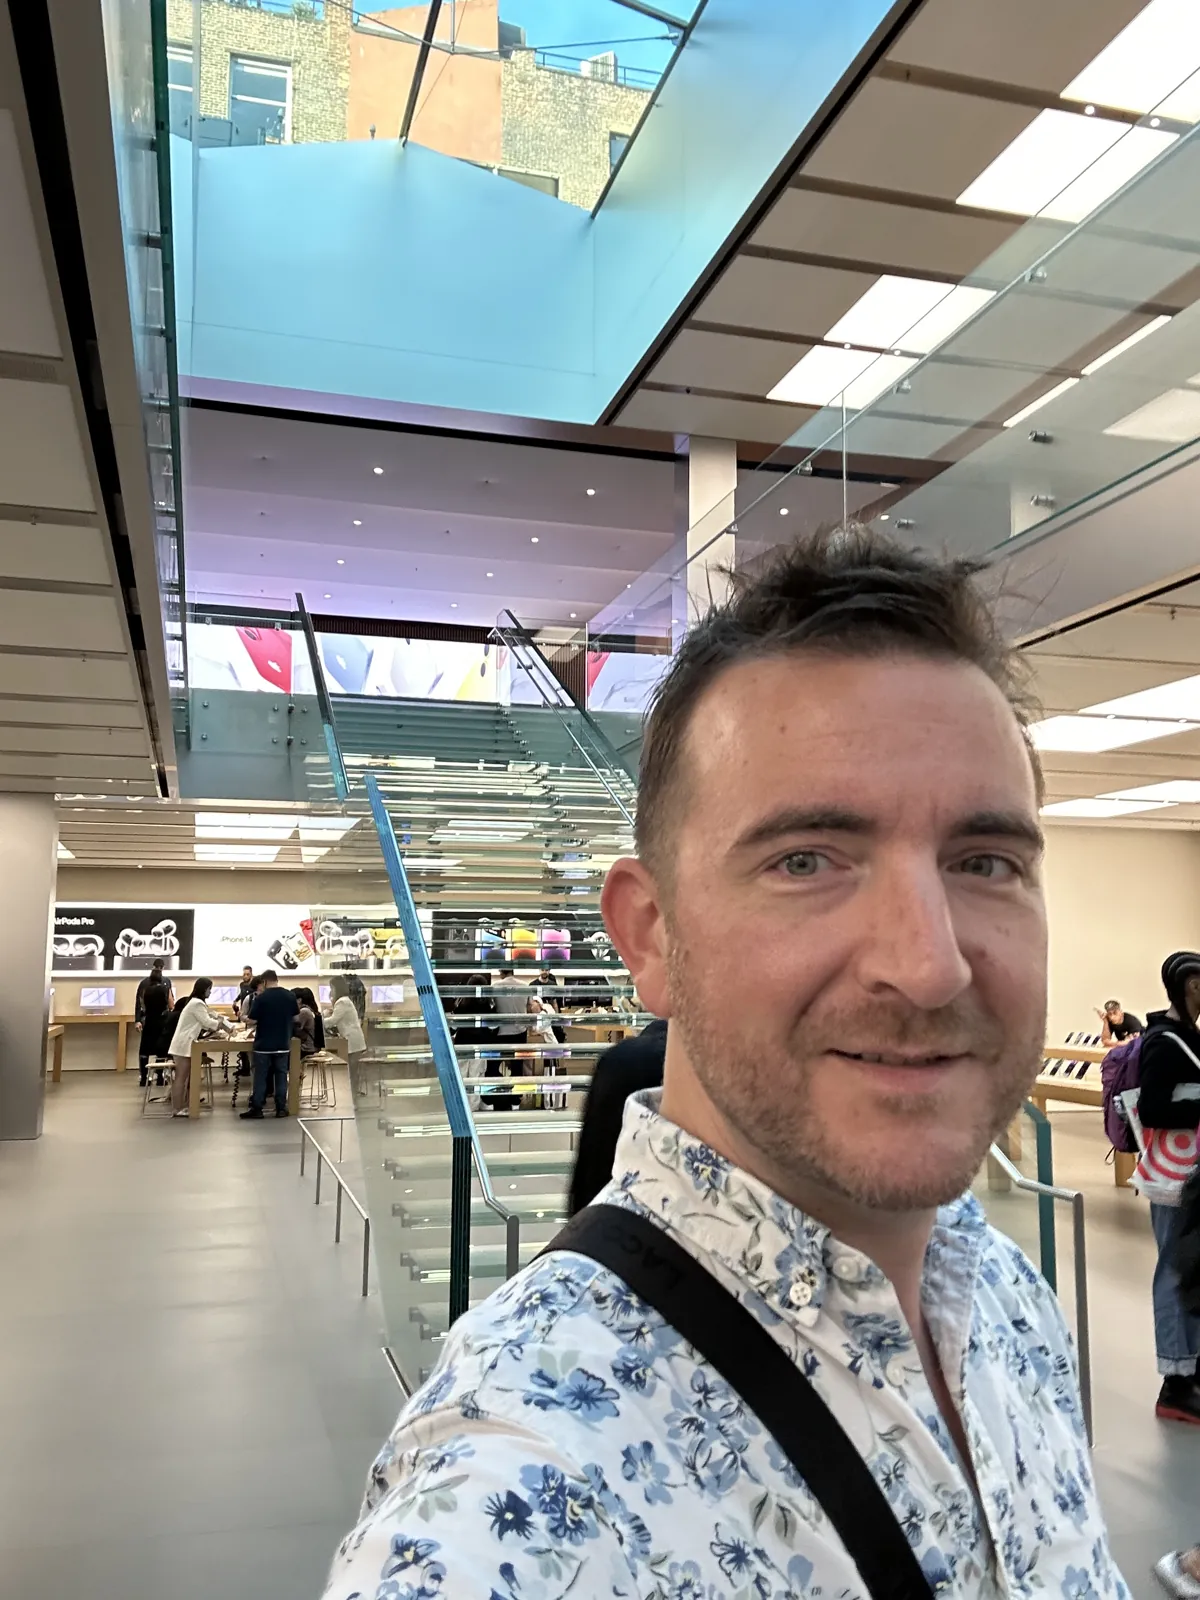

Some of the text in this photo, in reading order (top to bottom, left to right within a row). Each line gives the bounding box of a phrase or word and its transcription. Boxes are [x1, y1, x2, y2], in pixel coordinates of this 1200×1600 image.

[54, 917, 95, 925] irPods Pro
[220, 935, 253, 943] iPhone 14
